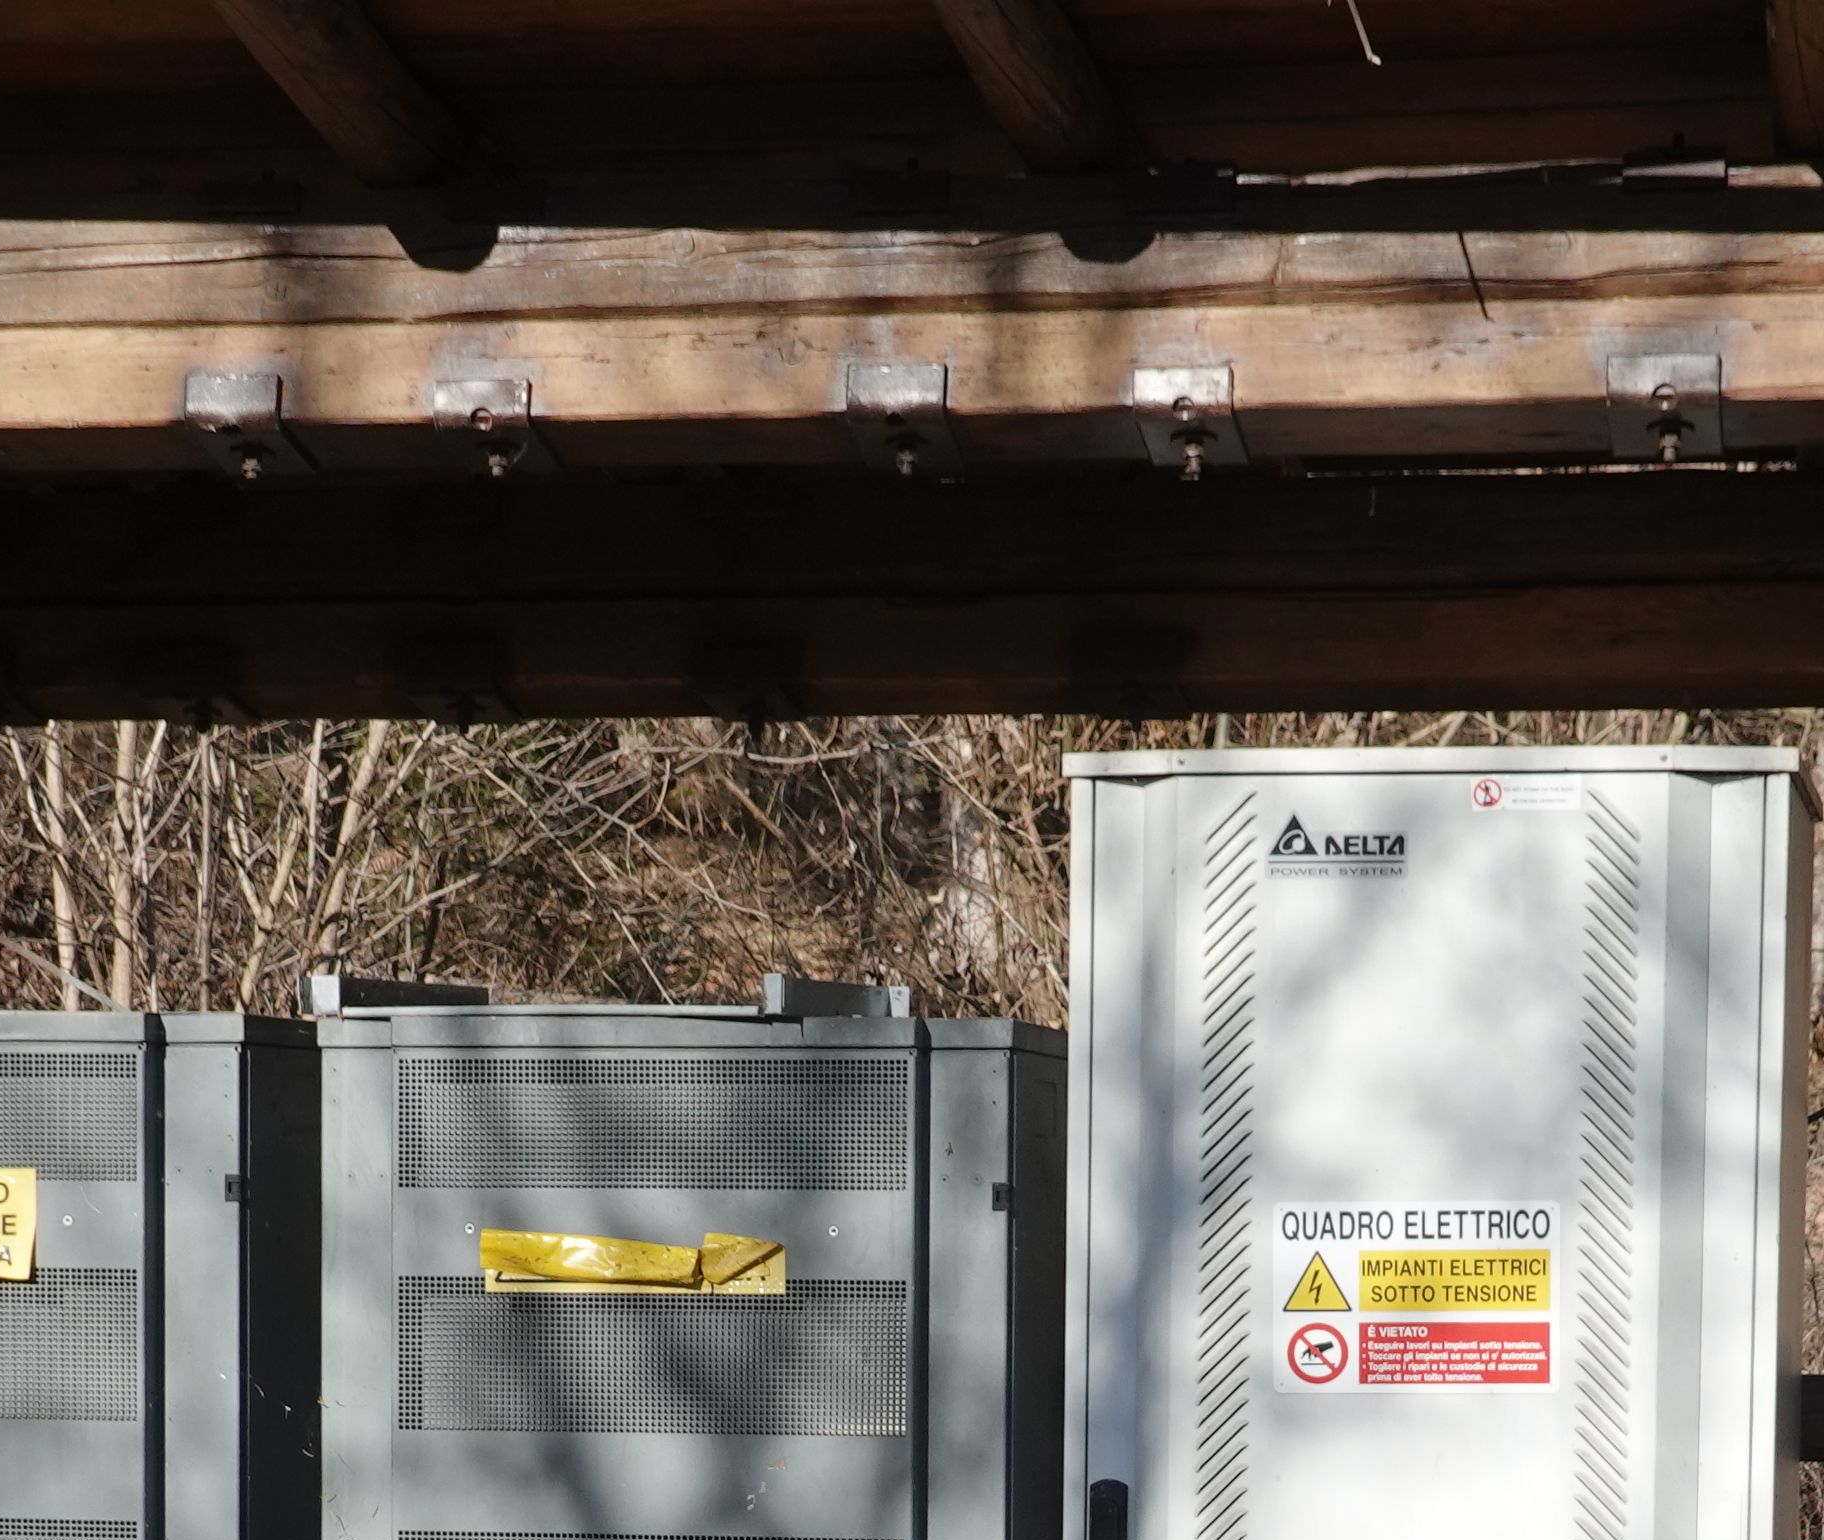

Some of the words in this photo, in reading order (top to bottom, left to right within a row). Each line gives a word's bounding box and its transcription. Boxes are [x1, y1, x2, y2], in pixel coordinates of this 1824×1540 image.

[1325, 834, 1405, 855] DELTA
[1270, 867, 1329, 876] POWER
[1338, 867, 1403, 876] SYSTEM
[1282, 1210, 1394, 1241] QUADRO
[1405, 1209, 1550, 1240] ELETTRICO
[1362, 1259, 1443, 1277] IMPIANTI
[1450, 1258, 1546, 1276] ELETTRICI
[1371, 1285, 1435, 1303] SOTTO
[1442, 1284, 1537, 1302] TENSIONE
[1379, 1326, 1428, 1338] VIETATO
